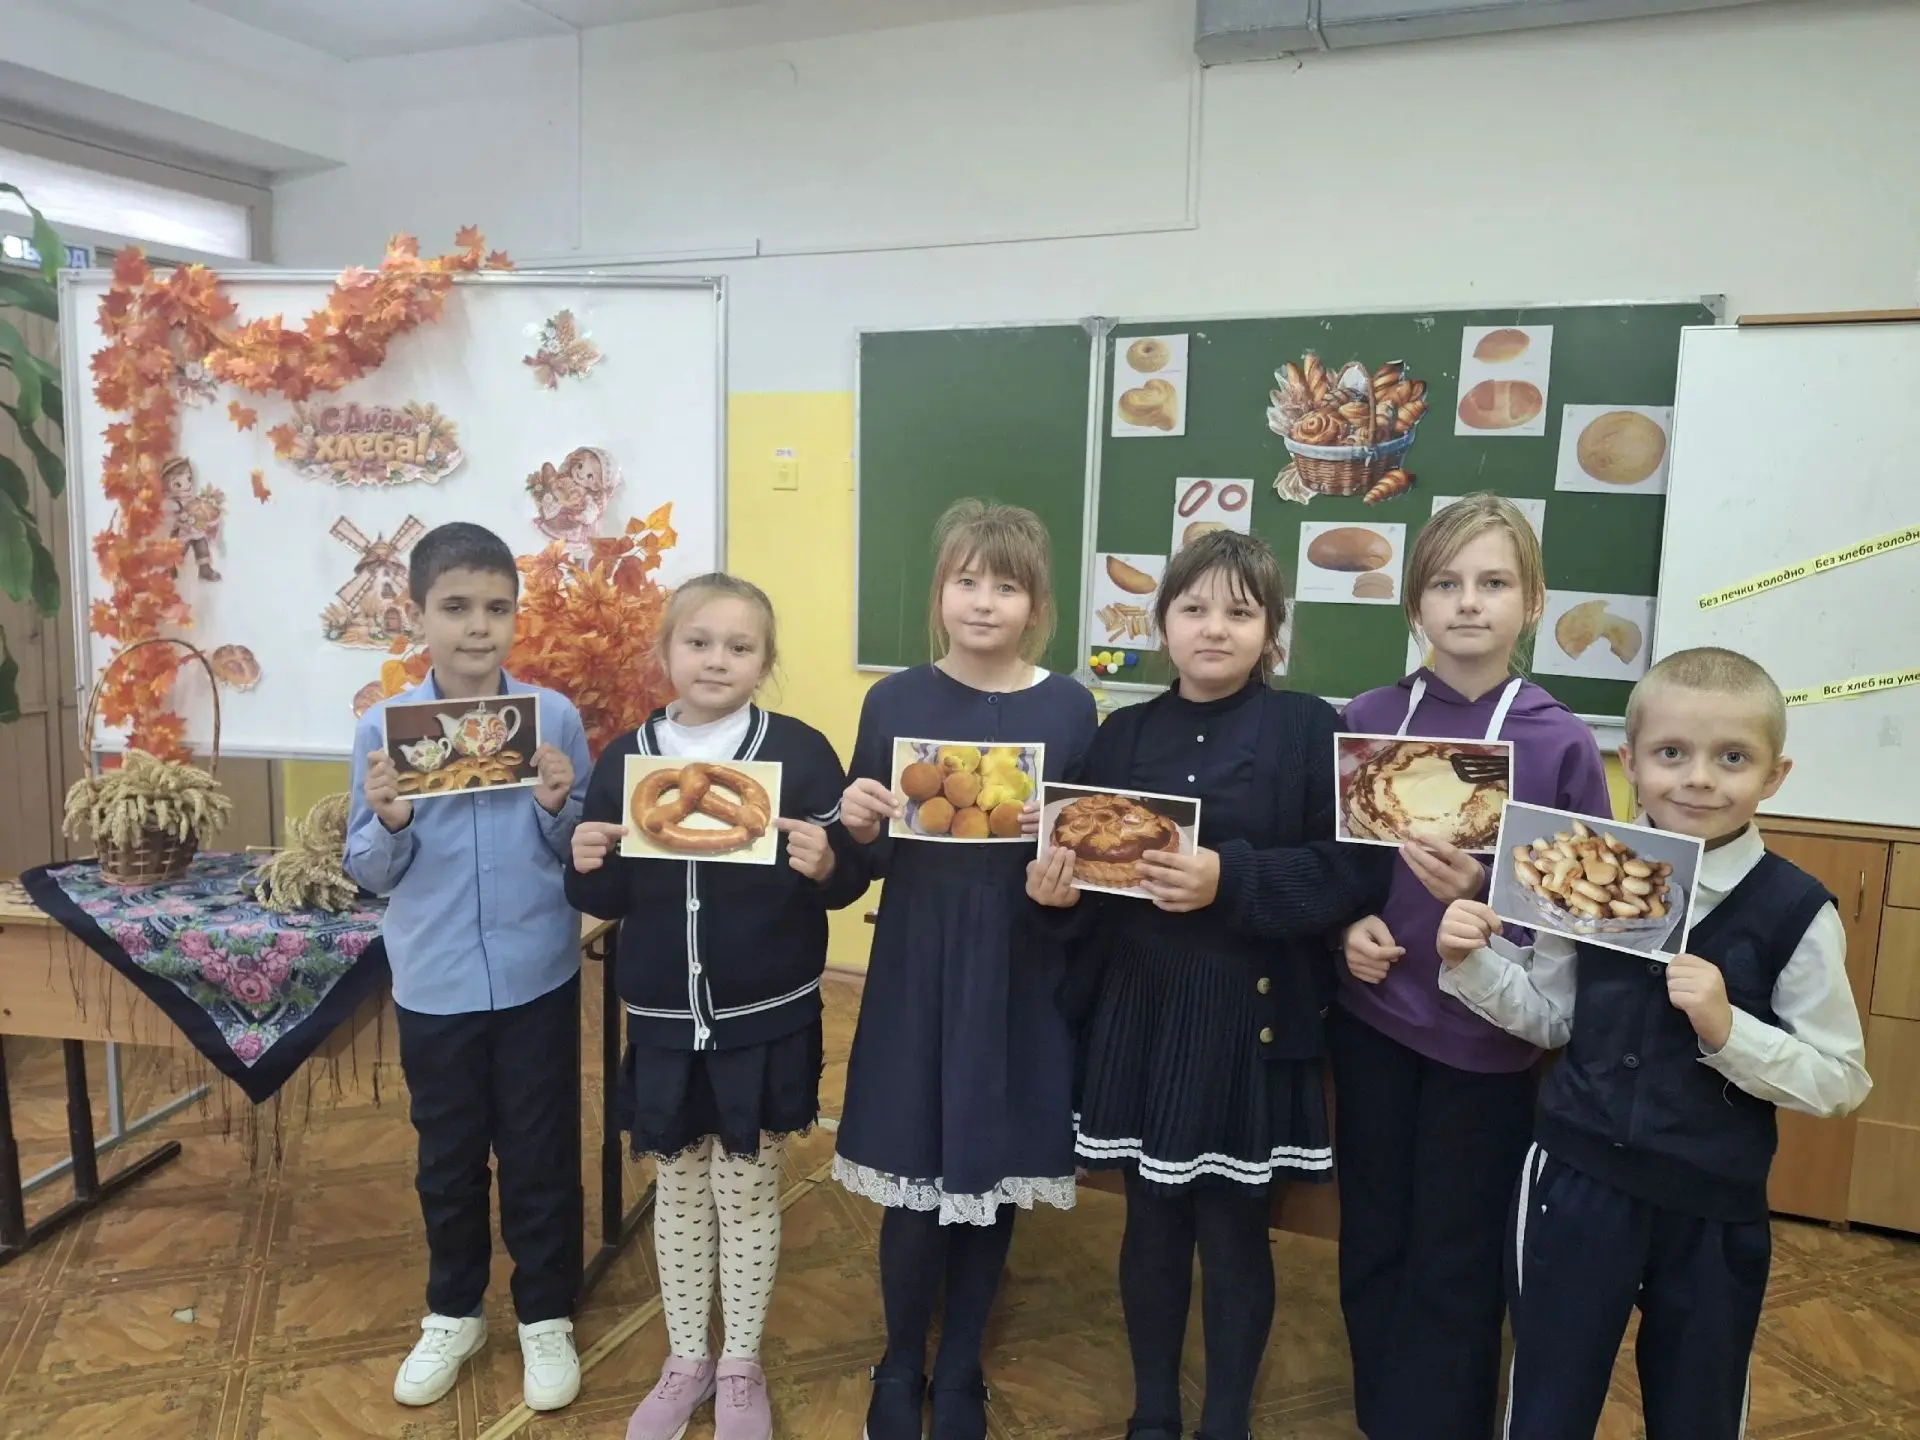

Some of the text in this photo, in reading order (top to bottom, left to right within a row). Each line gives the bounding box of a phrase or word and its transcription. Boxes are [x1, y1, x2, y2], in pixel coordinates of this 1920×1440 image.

[320, 407, 340, 434] С
[1815, 557, 1835, 569] Без
[1838, 545, 1873, 562] хлеба
[1699, 567, 1805, 609] Без печки холодно
[1846, 677, 1875, 692] хлеб
[1878, 677, 1894, 686] на
[1897, 673, 1920, 685] уме
[1785, 693, 1808, 704] уме
